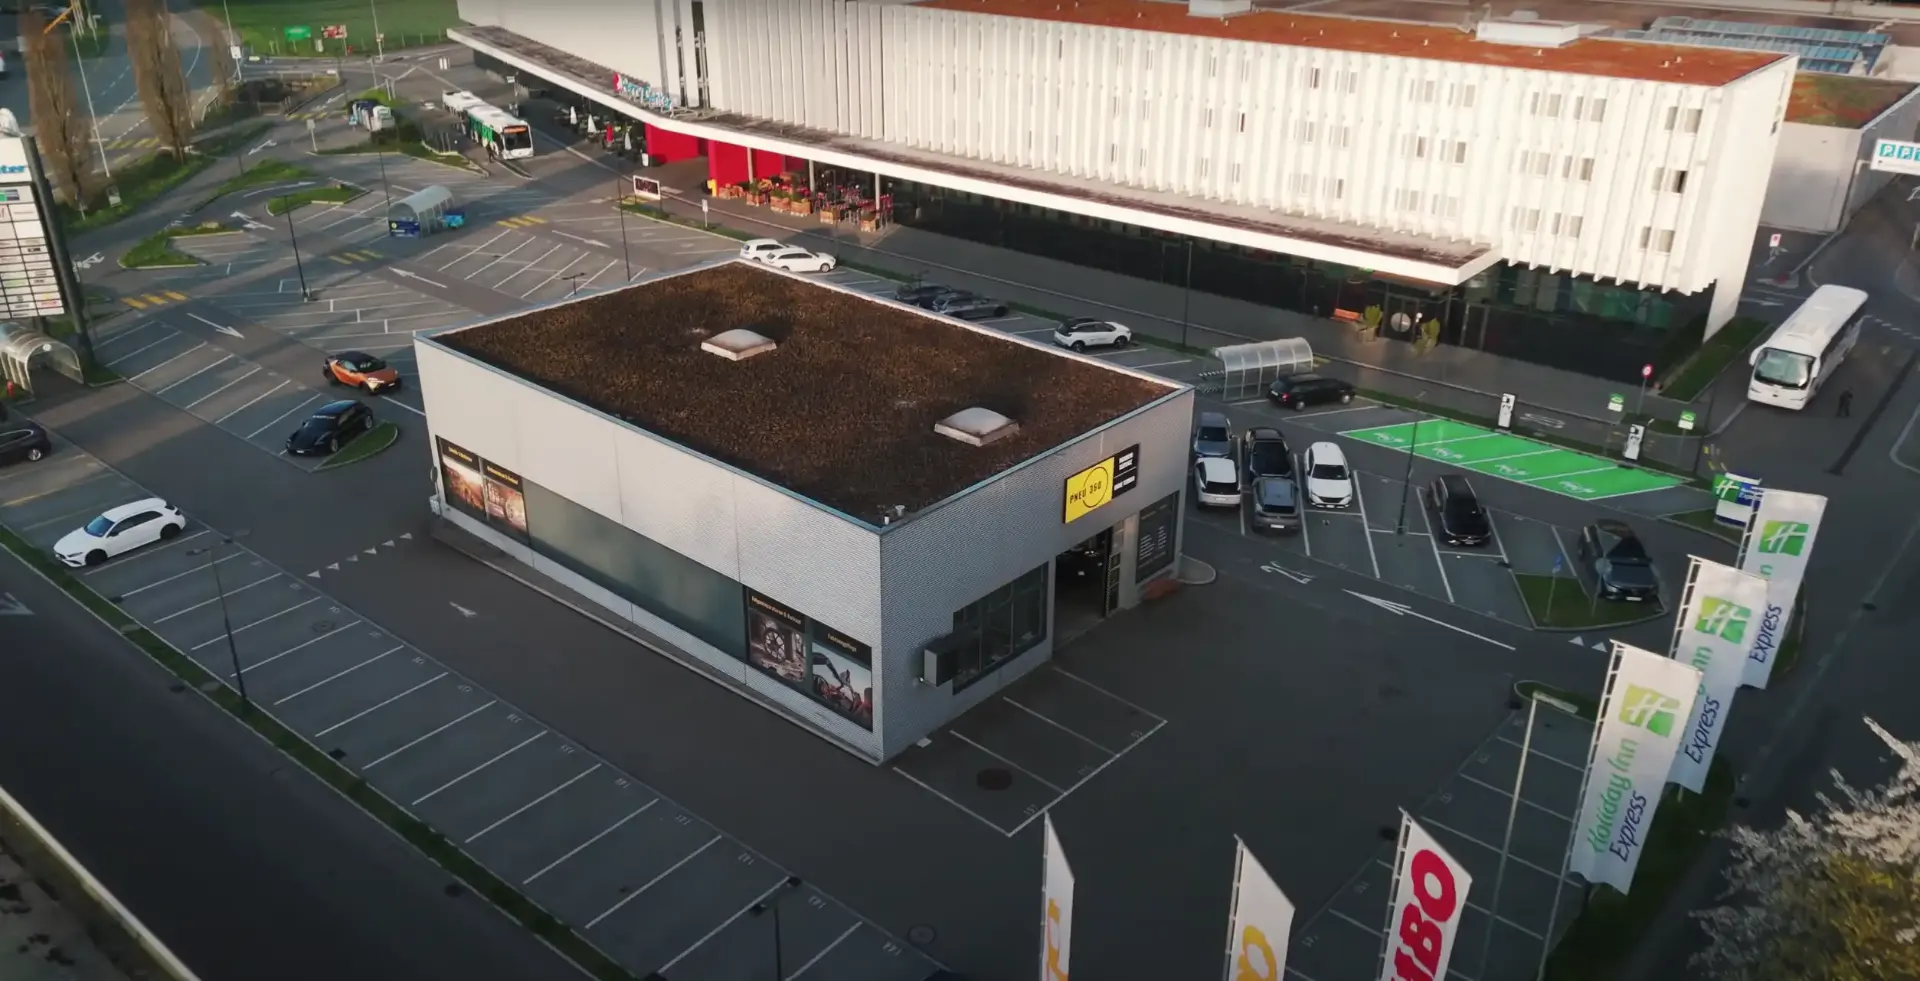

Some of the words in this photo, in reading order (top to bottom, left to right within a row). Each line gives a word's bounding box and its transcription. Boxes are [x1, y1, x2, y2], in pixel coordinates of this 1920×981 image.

[1069, 491, 1087, 504] PNEU
[1089, 480, 1102, 494] 360
[1748, 603, 1783, 664] Express
[1606, 737, 1639, 773] Inn
[1684, 695, 1721, 765] Express
[1587, 772, 1633, 853] Holiday
[1608, 790, 1648, 863] Express
